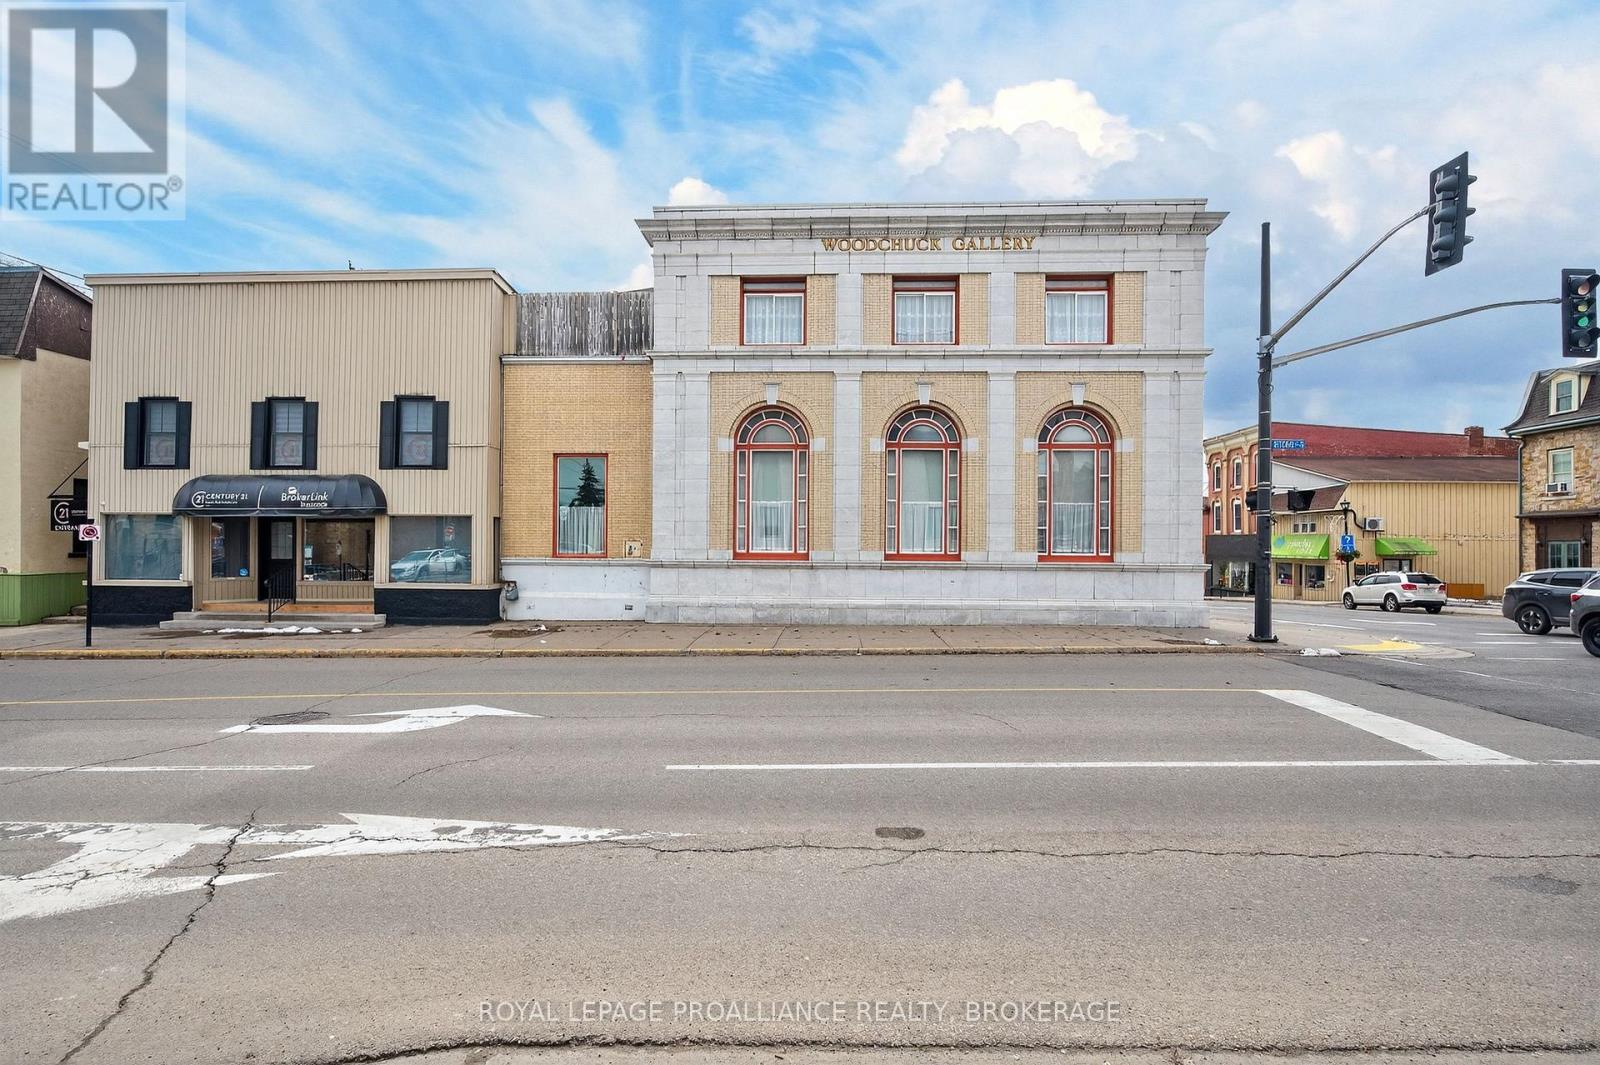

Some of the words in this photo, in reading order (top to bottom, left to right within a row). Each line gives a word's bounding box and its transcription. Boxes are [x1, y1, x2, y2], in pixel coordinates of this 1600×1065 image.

[821, 236, 942, 251] WOODCHUCK
[951, 236, 1036, 251] GALLERY
[205, 493, 240, 501] CENTURY
[281, 491, 329, 502] BrokerLink
